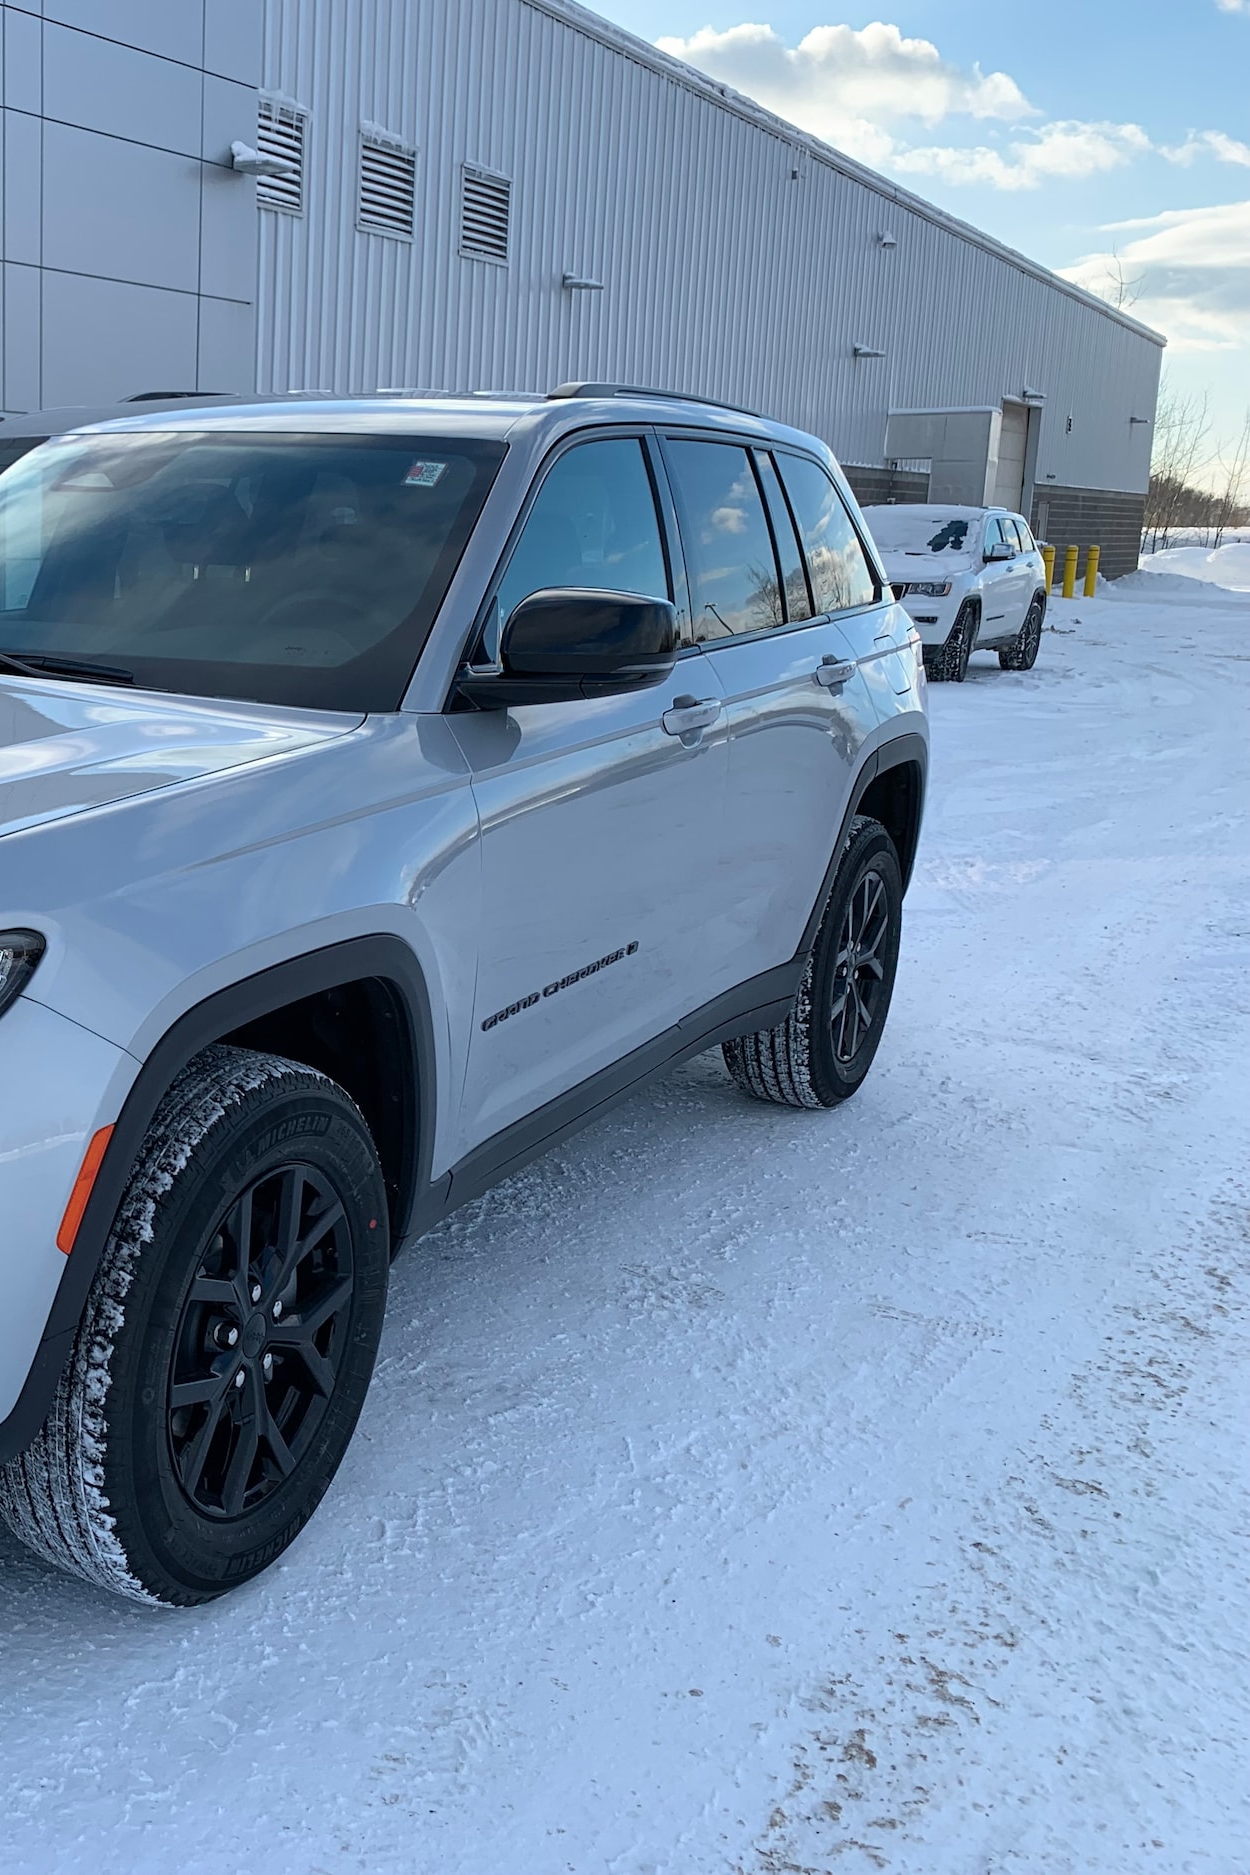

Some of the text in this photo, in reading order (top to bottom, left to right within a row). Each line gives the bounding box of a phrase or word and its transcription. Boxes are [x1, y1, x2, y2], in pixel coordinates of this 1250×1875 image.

[481, 948, 625, 1031] GRAND CHEROKEE
[256, 1116, 330, 1156] MICHELIN
